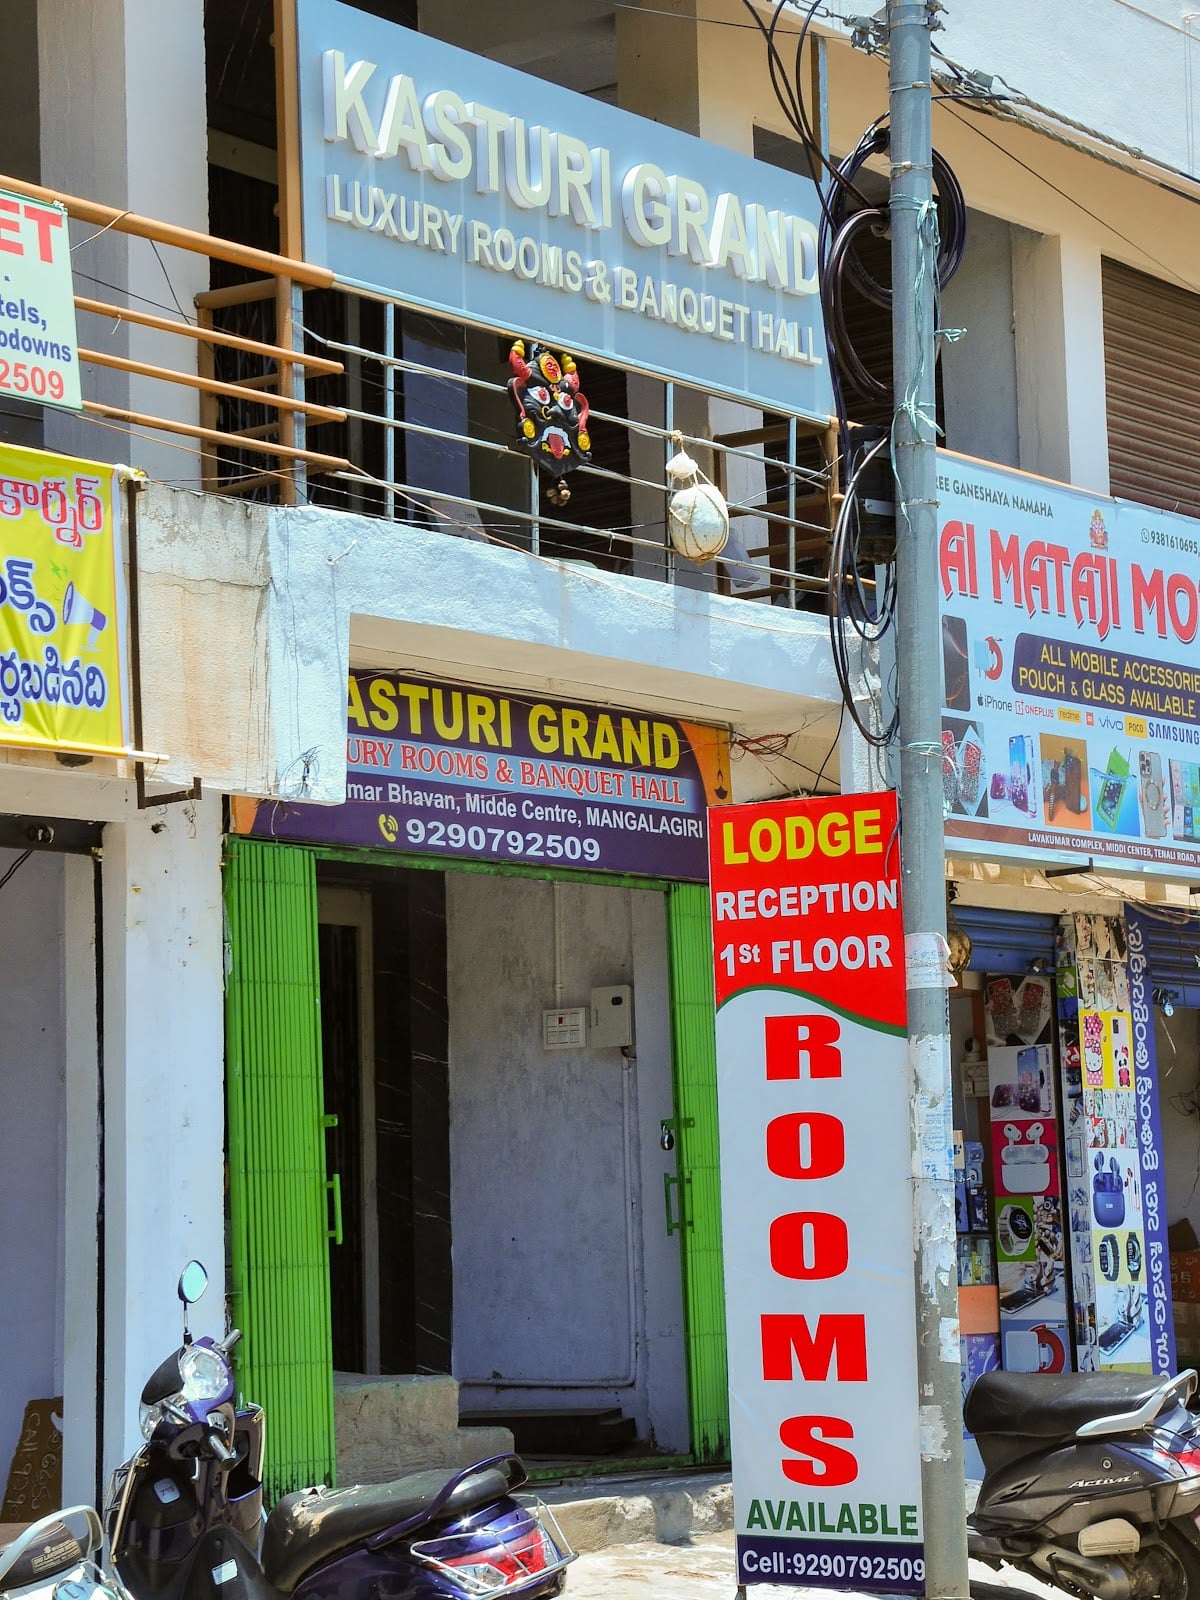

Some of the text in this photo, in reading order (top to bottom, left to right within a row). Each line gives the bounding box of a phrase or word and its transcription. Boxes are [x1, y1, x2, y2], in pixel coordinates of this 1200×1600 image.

[322, 49, 820, 296] KASTURI GRAND
[326, 174, 822, 366] LUXURY ROOMS & BANQUET HALL
[0, 358, 64, 399] 2509
[953, 480, 1009, 508] GANESHAYA
[1012, 496, 1053, 518] NAMAHA
[939, 520, 1200, 645] AI MATAJI MO
[1041, 644, 1066, 668] ALL
[1070, 650, 1120, 677] MOBILE
[985, 694, 1012, 712] iPhone
[1019, 667, 1196, 719] POUCH & GLASS AVAILABLE
[1025, 704, 1054, 718] ONEPLUS
[347, 676, 681, 770] ASTURI GRAND
[1099, 715, 1123, 731] vivo
[1128, 722, 1144, 733] POCO
[1148, 722, 1199, 745] SAMSUNG
[401, 744, 488, 780] ROOMS
[496, 755, 514, 784] &
[520, 760, 625, 798] BANQUET
[630, 775, 686, 804] HALL
[348, 783, 703, 839] mar Bhavan, Midde Centre, MANGALAGIRI
[406, 818, 601, 862] 9290792509
[722, 809, 883, 865] LODGE
[1028, 833, 1070, 846] LAVAKUMAR
[1071, 838, 1105, 852] COMPLEX,
[1106, 843, 1126, 854] MIDDI
[1127, 846, 1153, 858] CENTER,
[1154, 849, 1177, 860] TENALI
[1177, 851, 1196, 864] ROAD,
[716, 879, 897, 921] RECEPTION
[771, 935, 892, 974] FLOOR
[760, 1015, 868, 1488] ROOMS
[746, 1499, 919, 1536] AVAILABLE
